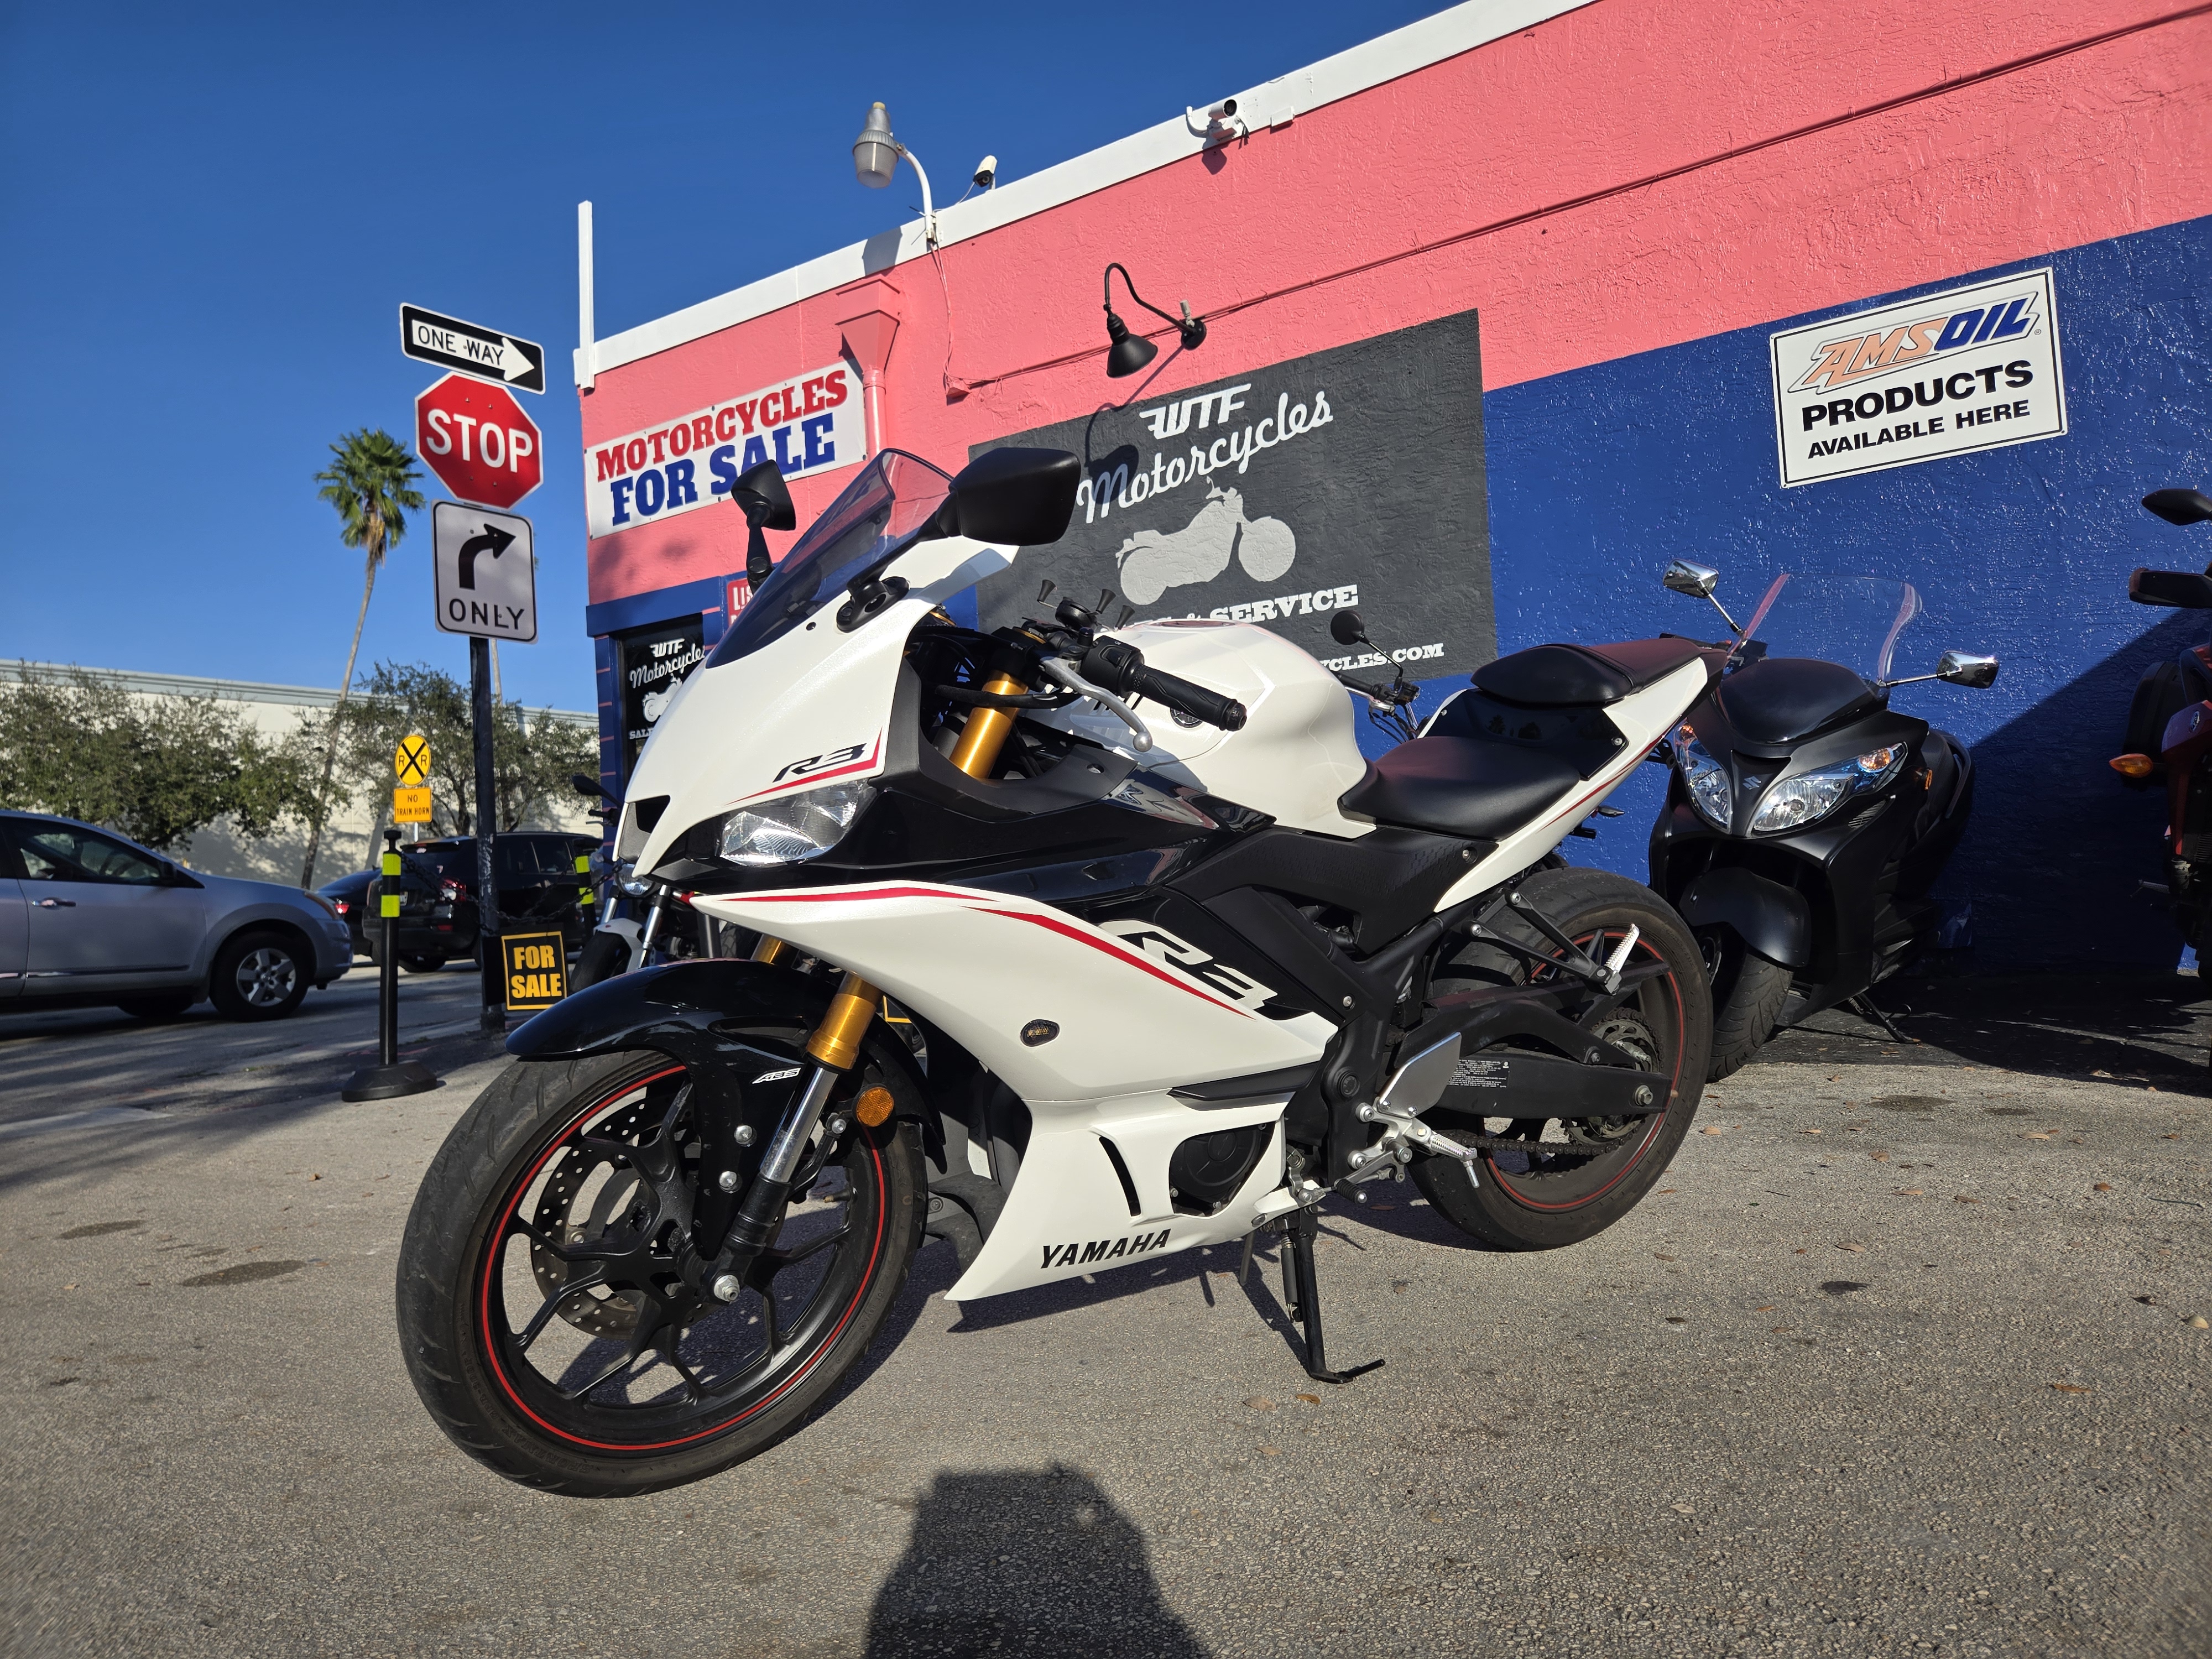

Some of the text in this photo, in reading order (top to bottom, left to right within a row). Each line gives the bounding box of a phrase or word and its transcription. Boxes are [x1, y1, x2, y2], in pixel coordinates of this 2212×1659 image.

[418, 325, 504, 366] ONE WAY
[1799, 296, 2030, 388] AMSOIL
[1139, 383, 1251, 440] WTF
[1802, 359, 2034, 432] PRODUCTS
[426, 408, 533, 473] STOP
[596, 369, 848, 483] MOTORCYCLES
[1807, 399, 2031, 460] AVAILABLE HERE
[1076, 390, 1334, 524] Motorcycles
[610, 458, 698, 526] FOR
[450, 597, 525, 630] ONLY
[1209, 584, 1359, 624] SERVICE
[649, 638, 685, 658] WTF
[772, 743, 867, 783] R3
[397, 807, 430, 816] TRAIN HORN
[407, 795, 418, 803] NO
[513, 945, 555, 971] FOR
[511, 973, 562, 999] SALE
[752, 1067, 801, 1084] ABS
[1040, 1228, 1171, 1269] YAMAHA
[502, 1423, 594, 1475] SPORTMAX
